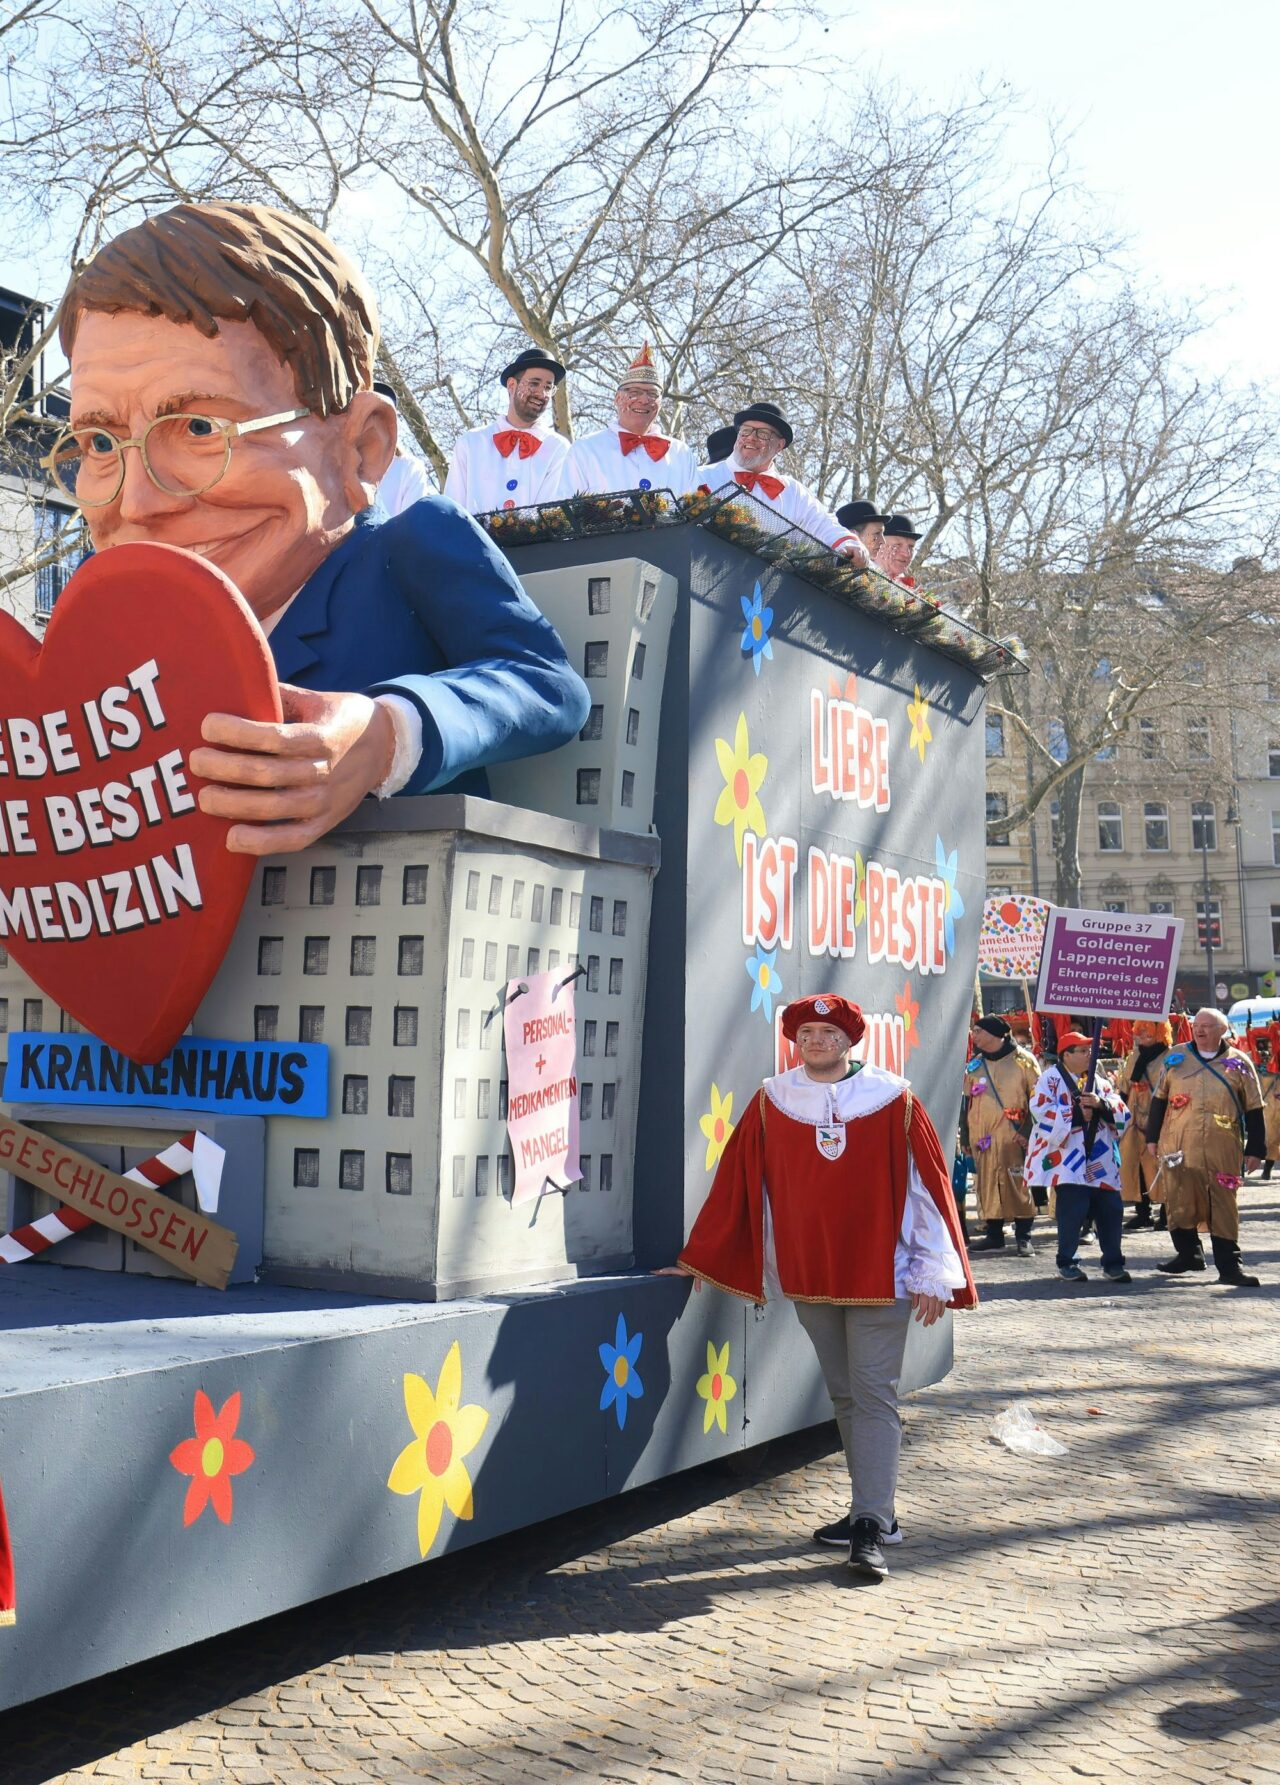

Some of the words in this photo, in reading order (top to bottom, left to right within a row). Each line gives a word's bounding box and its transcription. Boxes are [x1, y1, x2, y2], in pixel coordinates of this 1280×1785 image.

[81, 657, 166, 760] IST
[812, 691, 889, 810] LIEBE
[43, 748, 197, 854] BESTE
[744, 838, 796, 946] IST
[810, 850, 855, 953] DIE
[867, 865, 946, 971] BESTE
[979, 934, 1016, 945] umede
[1019, 933, 1044, 943] Thea
[1082, 918, 1132, 933] Gruppe
[1135, 923, 1152, 933] 37
[988, 943, 1043, 954] Heimatverein
[1076, 936, 1152, 953] Goldener
[1057, 950, 1165, 969] Lappenclown
[1058, 967, 1131, 983] Ehrenpreis
[1134, 974, 1159, 985] des
[1049, 993, 1093, 1004] Karneval
[1116, 998, 1140, 1007] 1823
[1143, 1001, 1161, 1009] e.V.
[1051, 983, 1121, 996] Festkomitee
[1123, 988, 1161, 1000] Kölner
[523, 1010, 572, 1045] PERSONAL-
[20, 1043, 309, 1104] KRANKENHAUS
[509, 1076, 577, 1122] MEDIKAMENTEN
[521, 1126, 570, 1169] MANGEL
